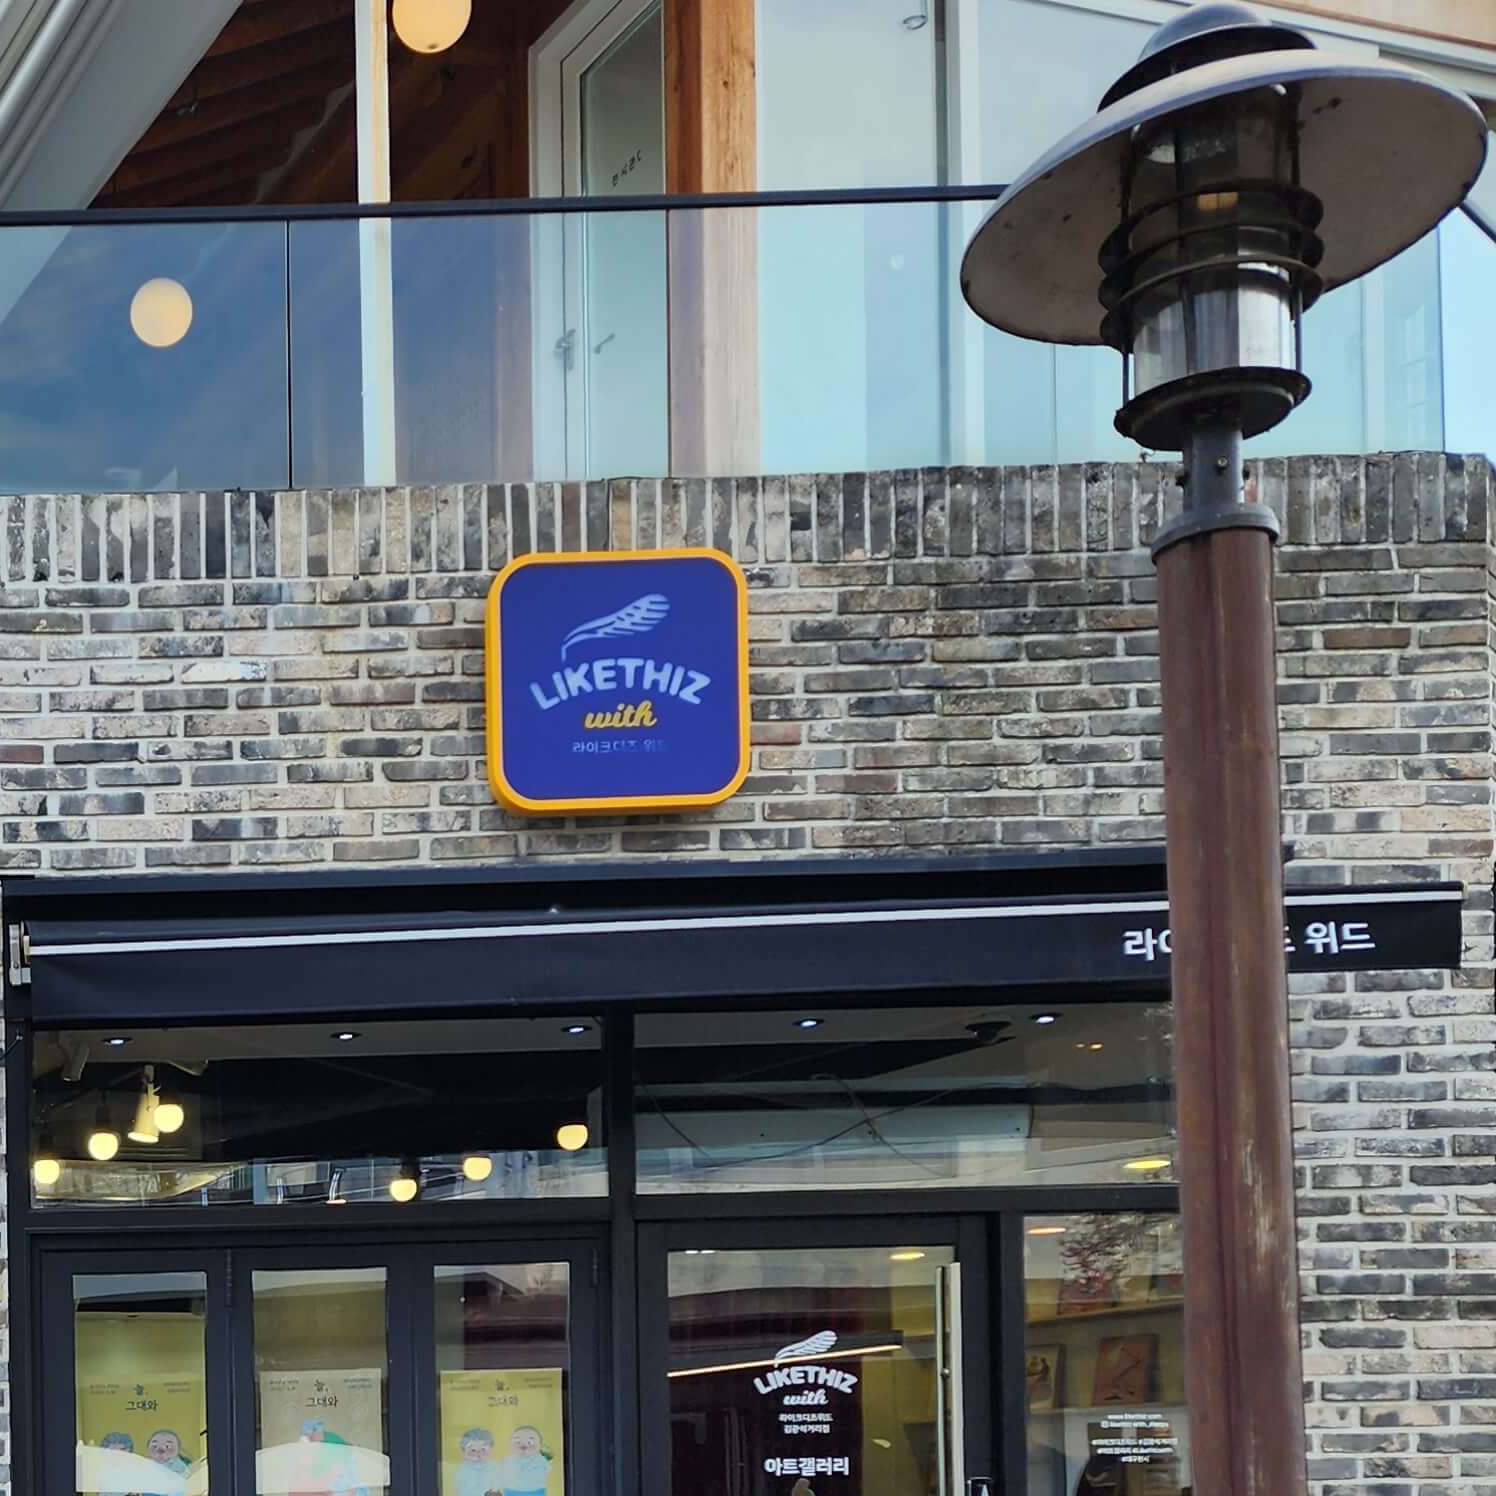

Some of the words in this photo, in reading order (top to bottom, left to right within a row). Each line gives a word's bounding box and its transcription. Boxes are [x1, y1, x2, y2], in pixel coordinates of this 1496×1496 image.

[529, 657, 712, 710] LIKETHIZ
[584, 700, 658, 728] with
[1304, 920, 1376, 954] 위드
[753, 1364, 858, 1394] LIKETHIZ
[783, 1388, 829, 1405] with
[763, 1456, 849, 1477] 아트갤러리
